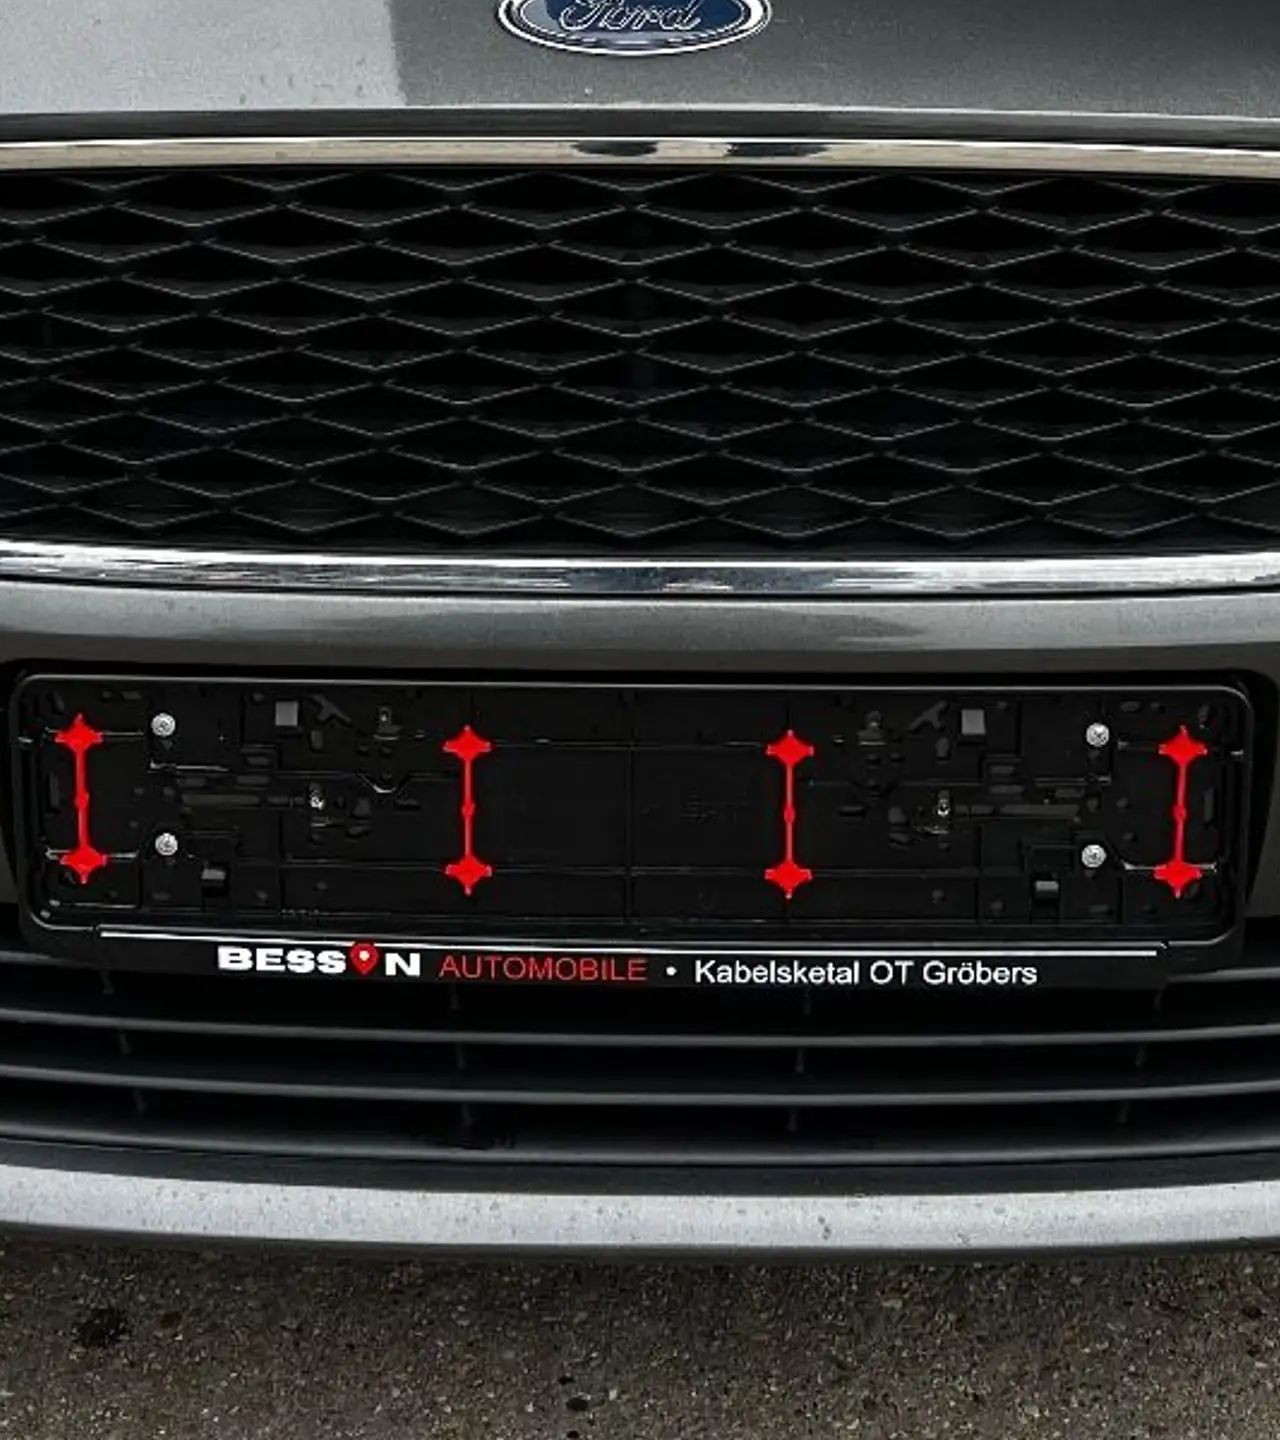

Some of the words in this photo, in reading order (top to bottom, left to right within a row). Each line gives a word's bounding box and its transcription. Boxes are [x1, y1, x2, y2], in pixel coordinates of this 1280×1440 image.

[438, 955, 647, 981] AUTOMOBILE
[694, 959, 860, 984] Kabelsketal
[870, 960, 914, 984] OT
[922, 960, 1037, 985] Gröbers
